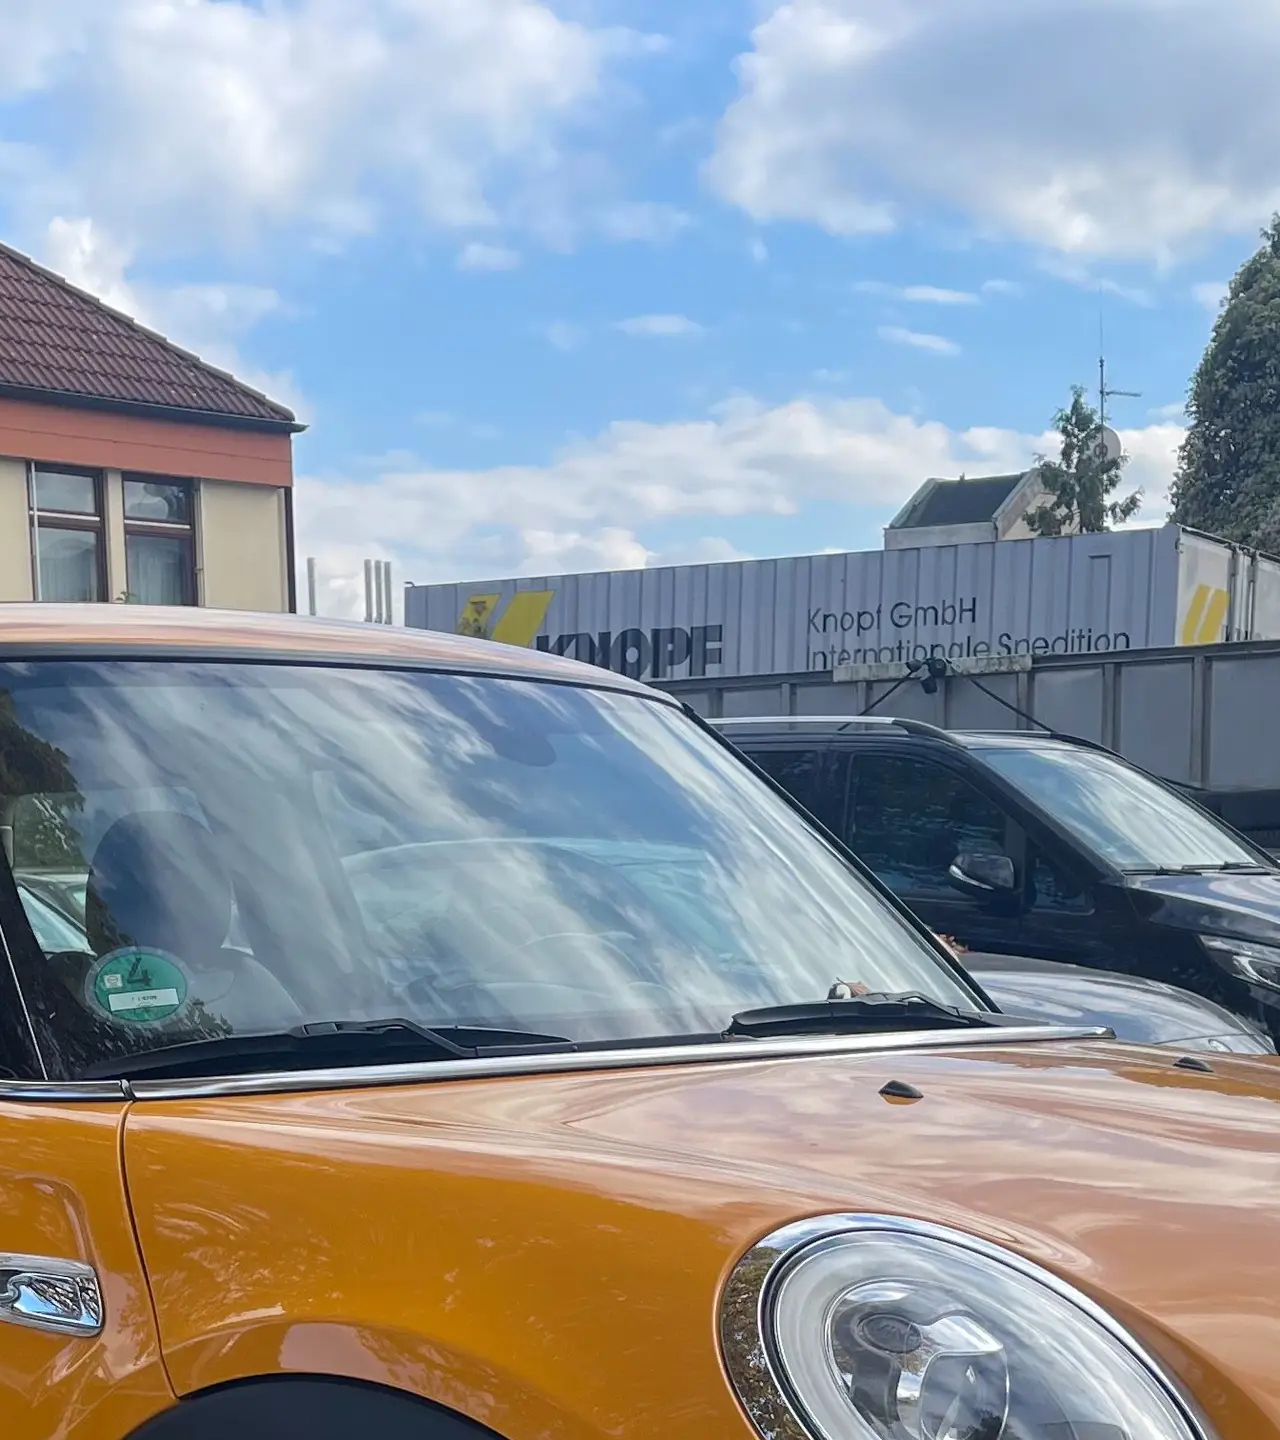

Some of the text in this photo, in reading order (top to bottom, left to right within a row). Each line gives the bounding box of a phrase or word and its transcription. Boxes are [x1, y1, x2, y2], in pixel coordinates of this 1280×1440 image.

[807, 597, 977, 637] Knopf GmbH
[806, 635, 990, 671] Internationale
